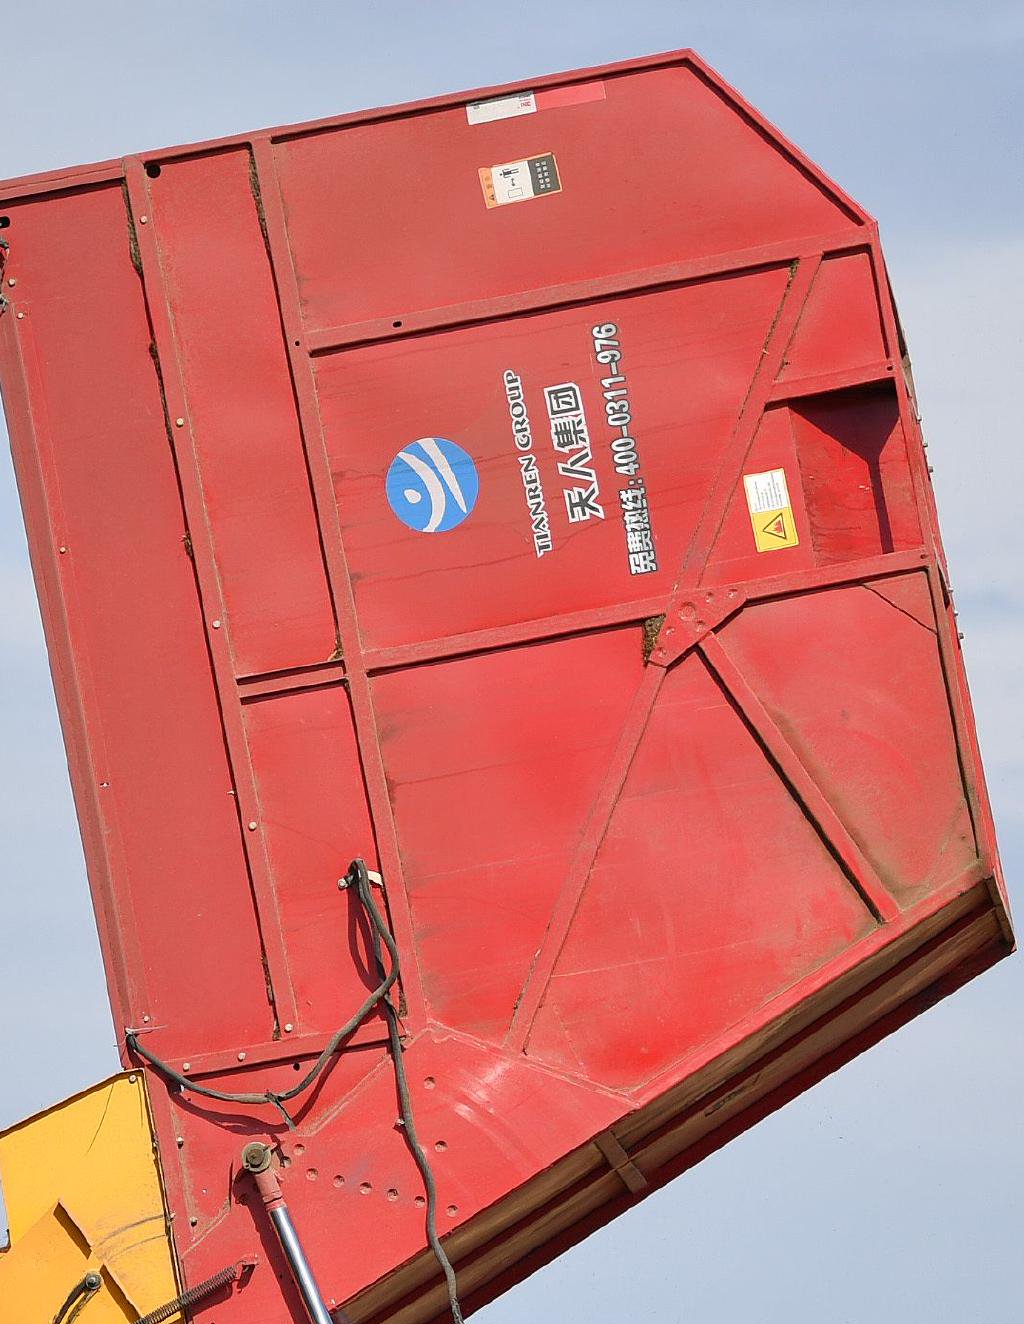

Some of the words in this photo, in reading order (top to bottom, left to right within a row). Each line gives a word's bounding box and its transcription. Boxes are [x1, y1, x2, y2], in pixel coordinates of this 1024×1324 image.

[502, 368, 533, 451] GROUP
[543, 381, 606, 524] 天人集团
[517, 453, 553, 559] TIANREN
